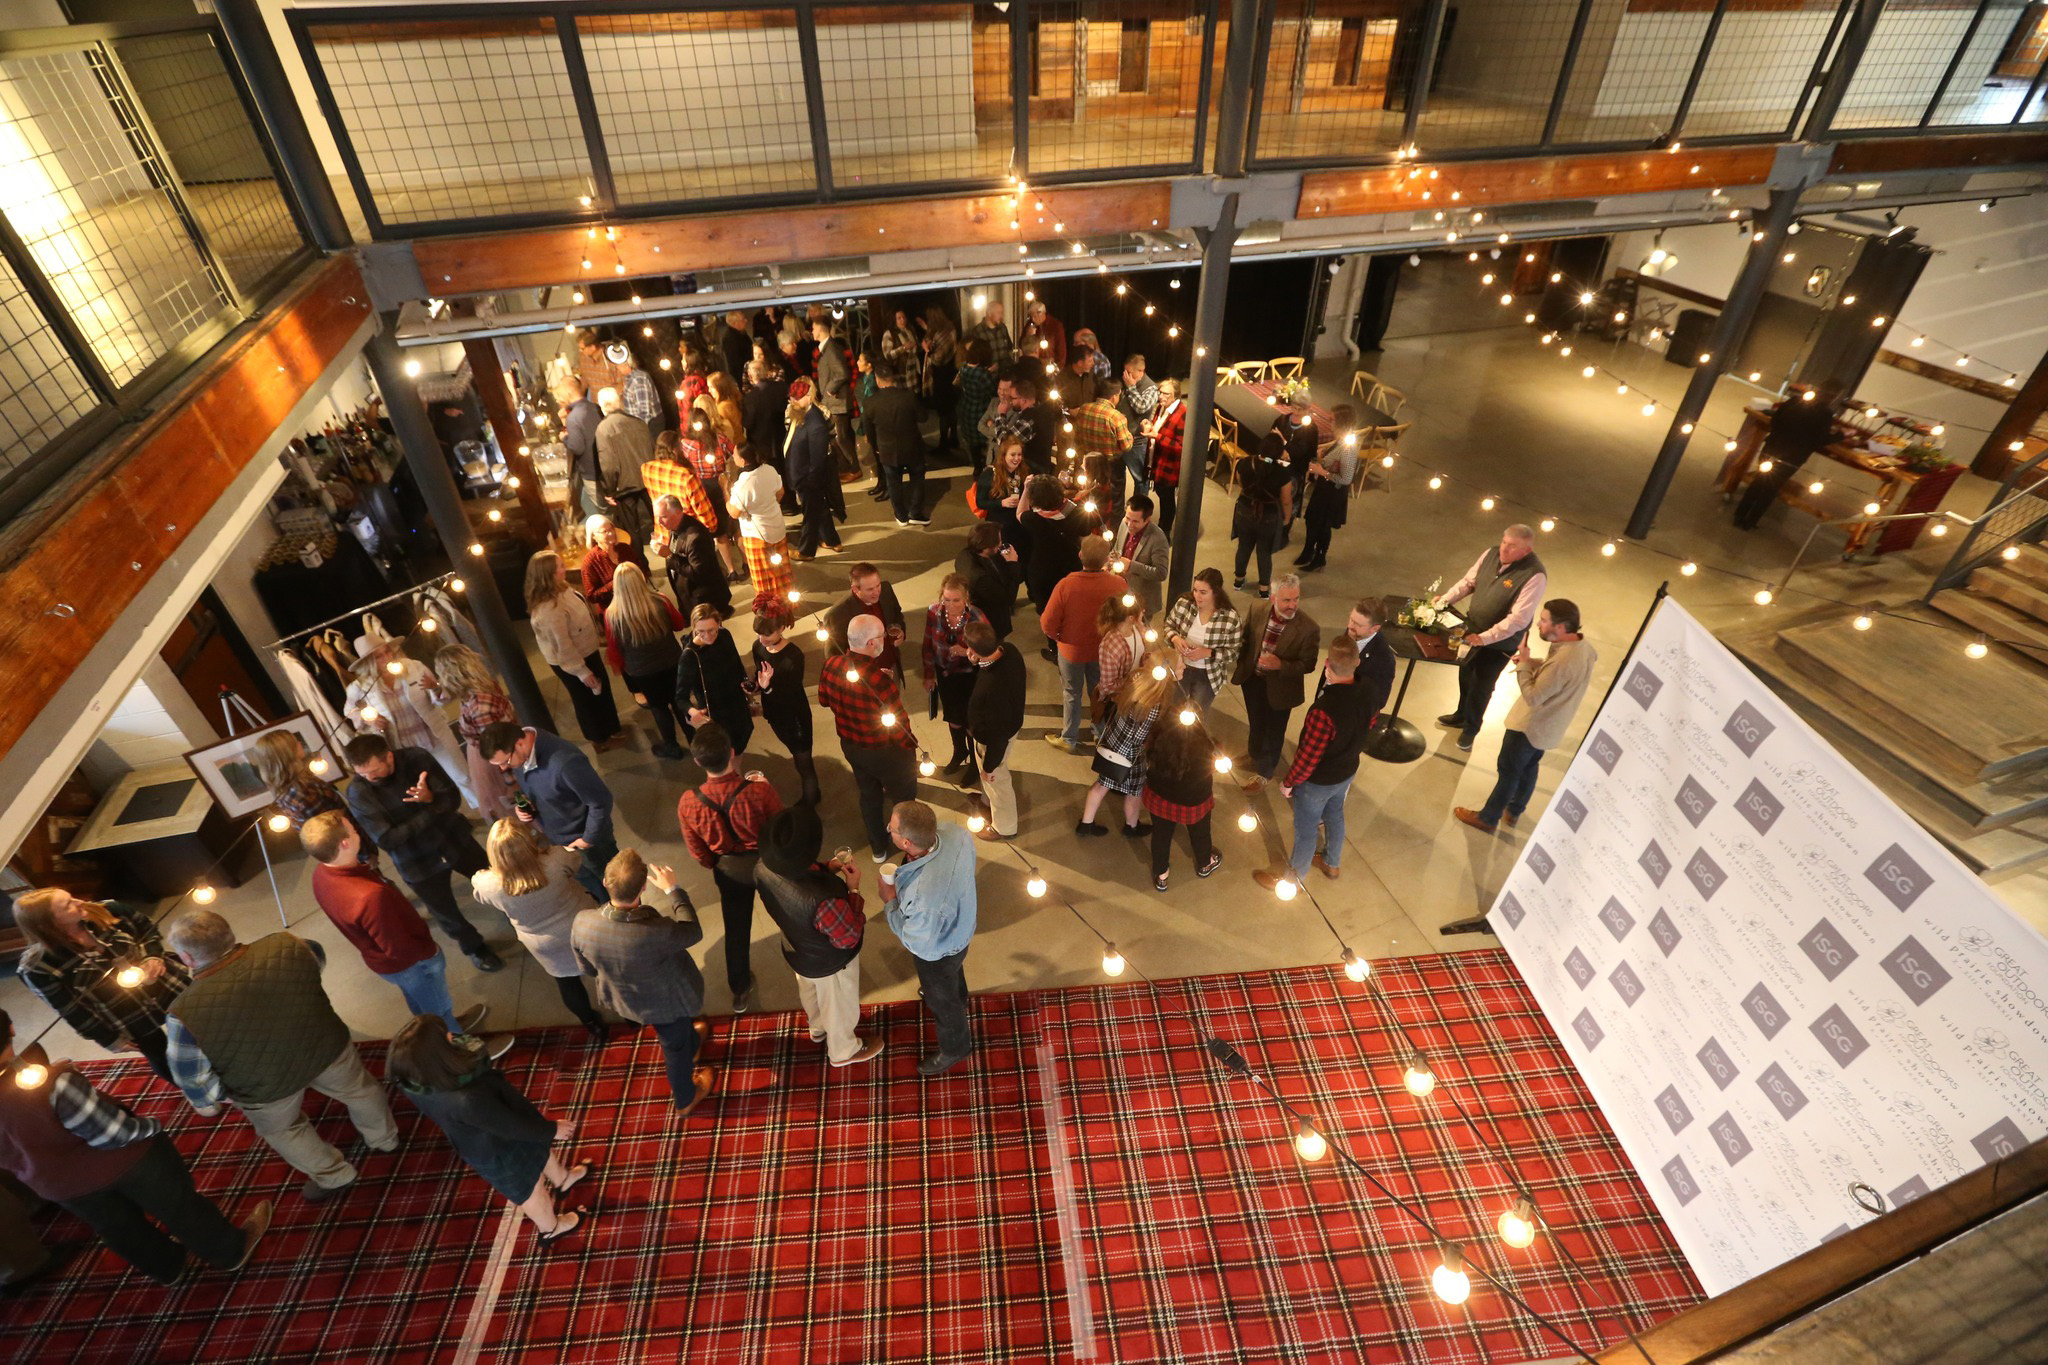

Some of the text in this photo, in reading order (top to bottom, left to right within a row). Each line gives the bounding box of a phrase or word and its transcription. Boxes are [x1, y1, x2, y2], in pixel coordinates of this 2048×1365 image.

[1632, 674, 1653, 698] ISG
[1733, 715, 1759, 743] ISG
[1595, 740, 1614, 763] ISG
[1682, 788, 1704, 814] ISG
[1815, 774, 1839, 797] GREAT
[1562, 799, 1579, 821] ISG
[1745, 792, 1772, 821] ISG
[1763, 759, 1782, 778] wild
[1781, 778, 1812, 809] prairie
[1813, 809, 1859, 856] showdown
[1815, 786, 1858, 829] OUTDOORS
[1532, 852, 1548, 874] ISG
[1646, 850, 1664, 876] ISG
[1693, 860, 1716, 888] ISG
[1754, 848, 1775, 873] GREAT
[1826, 858, 1851, 885] GREAT
[1709, 831, 1727, 849] wild
[1726, 850, 1753, 879] prairie
[1755, 881, 1795, 927] showdown
[1755, 859, 1793, 902] OUTDOORS
[1777, 838, 1797, 859] wild
[1796, 860, 1828, 893] prairie
[1830, 894, 1876, 944] showdown
[1878, 860, 1914, 894] ISG
[1505, 899, 1519, 921] ISG
[1829, 871, 1874, 918] OUTDOORS
[1606, 907, 1626, 931] ISG
[1655, 919, 1673, 946] ISG
[1720, 906, 1737, 925] wild
[1736, 927, 1764, 958] prairie
[1765, 961, 1806, 1009] showdown
[1766, 939, 1804, 985] OUTDOORS
[1812, 933, 1842, 966] ISG
[1993, 946, 2029, 978] GREAT
[1570, 956, 1588, 980] ISG
[1616, 971, 1636, 996] ISG
[1896, 952, 1932, 989] ISG
[1923, 917, 2048, 1047] wild prairie showdow
[1986, 962, 2029, 1005] FOUNDATION
[1994, 960, 2048, 1017] OUTDOOR
[1751, 995, 1777, 1027] ISG
[1579, 1017, 1597, 1042] ISG
[1822, 1019, 1853, 1053] ISG
[1905, 1019, 1933, 1049] GREAT
[1705, 1049, 1728, 1079] ISG
[1847, 988, 1966, 1119] wild prairie showdown
[1906, 1033, 1959, 1090] OUTDOORS
[2008, 1050, 2043, 1086] GREAT
[1939, 1014, 2048, 1132] wild prairie show
[2008, 1064, 2048, 1105] OUTD
[1767, 1075, 1795, 1107] ISG
[1835, 1079, 1862, 1107] GREAT
[1663, 1095, 1684, 1124] ISG
[1784, 1049, 1804, 1071] wild
[1804, 1074, 1839, 1111] prairie
[1841, 1115, 1885, 1174] showdown
[1838, 1092, 1885, 1147] OUTDOORS
[1718, 1123, 1741, 1154] ISG
[1862, 1077, 1952, 1184] wild prairie show
[1926, 1114, 1954, 1145] GREAT
[1735, 1099, 1752, 1121] wild
[1751, 1124, 1777, 1160] prairie
[1778, 1165, 1816, 1221] showdown
[1927, 1127, 1969, 1178] OUTDOO
[1990, 1134, 2014, 1159] IS
[1670, 1165, 1690, 1195] ISG
[1802, 1130, 1822, 1154] wild
[1819, 1158, 1850, 1198] prairie
